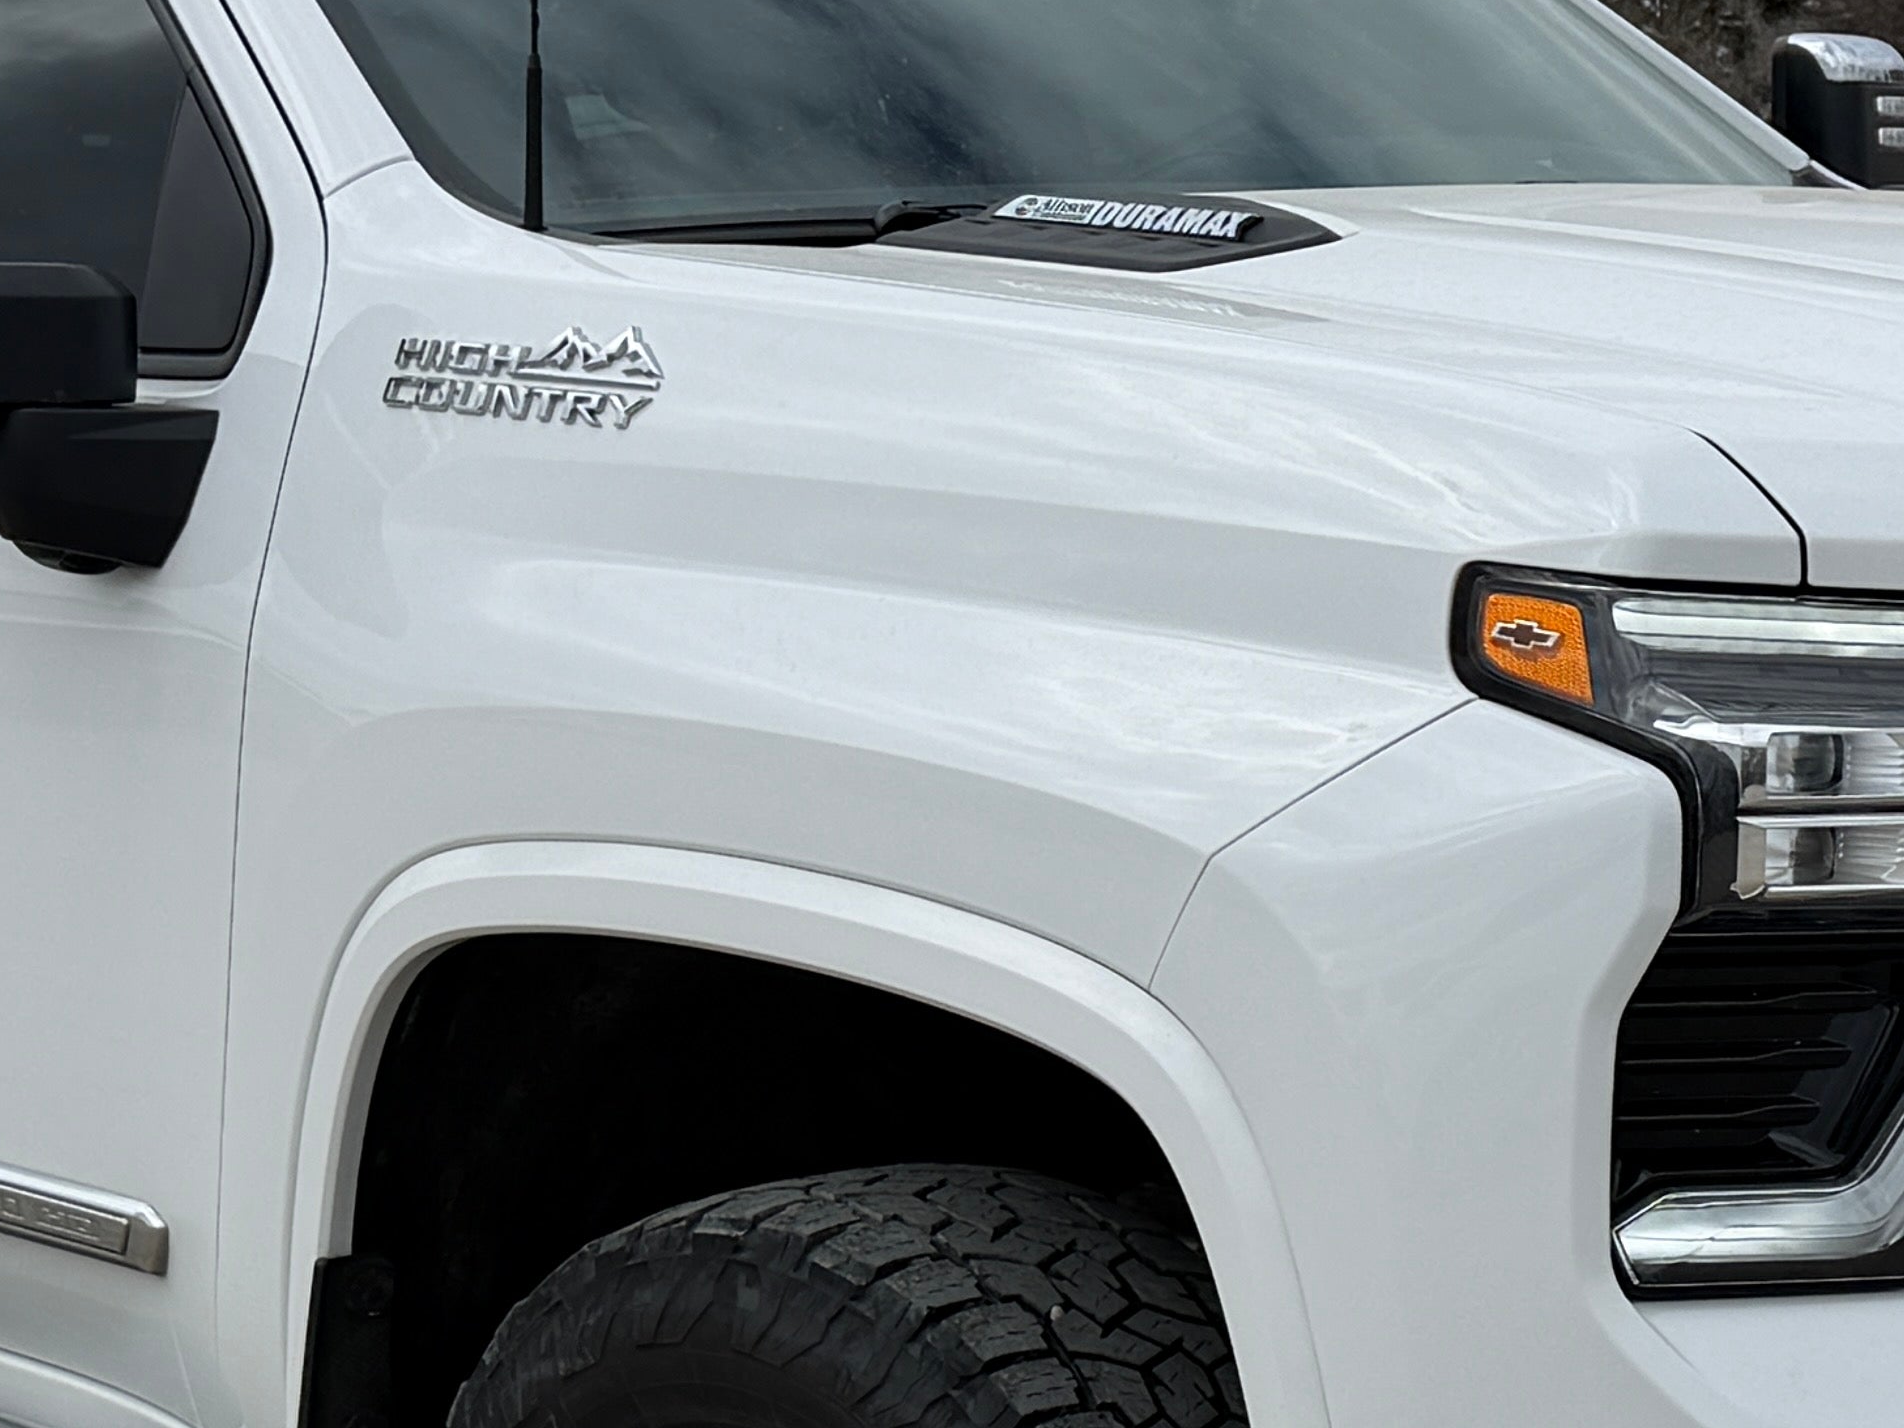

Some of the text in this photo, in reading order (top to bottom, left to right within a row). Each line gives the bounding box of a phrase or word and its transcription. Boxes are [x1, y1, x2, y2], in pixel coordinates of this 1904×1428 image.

[1092, 200, 1250, 239] DURAMAX
[395, 338, 530, 375] HIGH
[382, 375, 654, 430] COUNTRY
